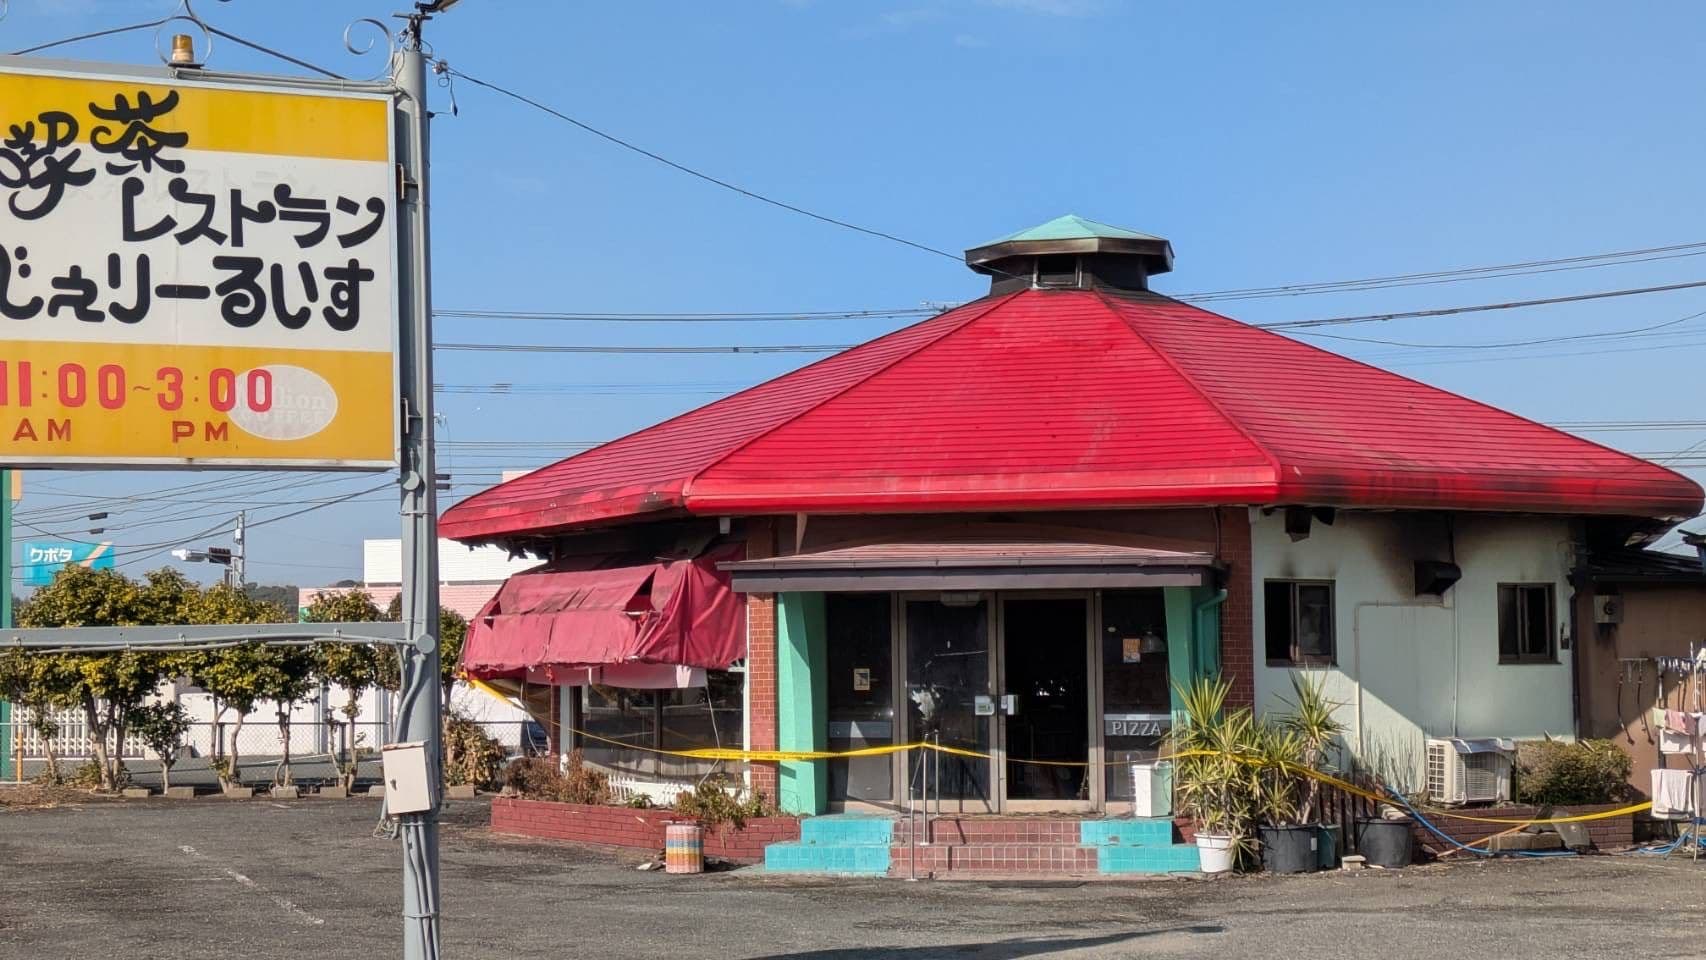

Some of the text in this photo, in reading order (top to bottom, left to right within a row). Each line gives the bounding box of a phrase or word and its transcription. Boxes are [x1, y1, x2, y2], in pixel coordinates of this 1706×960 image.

[121, 177, 385, 248] レストラン
[12, 418, 228, 443] AM PM
[30, 547, 73, 563] クボタ
[1111, 721, 1162, 736] PIZZA
